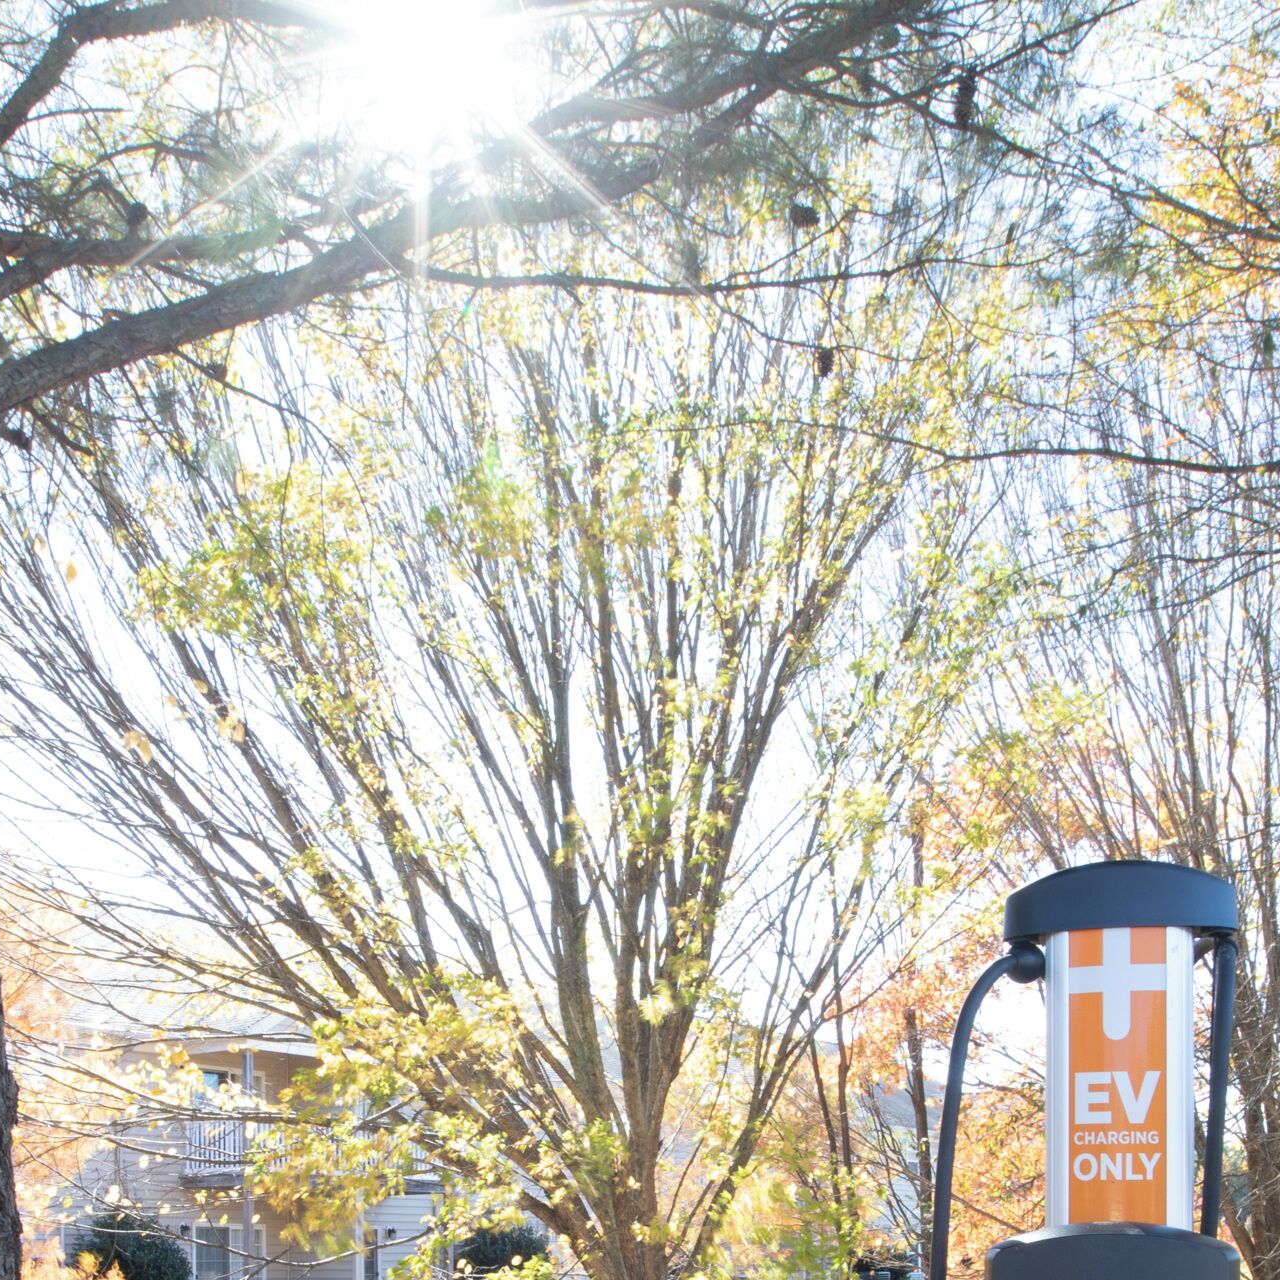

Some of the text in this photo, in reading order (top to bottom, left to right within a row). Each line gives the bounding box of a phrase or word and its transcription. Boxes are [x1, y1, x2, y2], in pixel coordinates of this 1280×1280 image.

[1074, 1070, 1161, 1125] EV
[1074, 1131, 1159, 1145] CHARGING
[1073, 1152, 1161, 1181] ONLY
